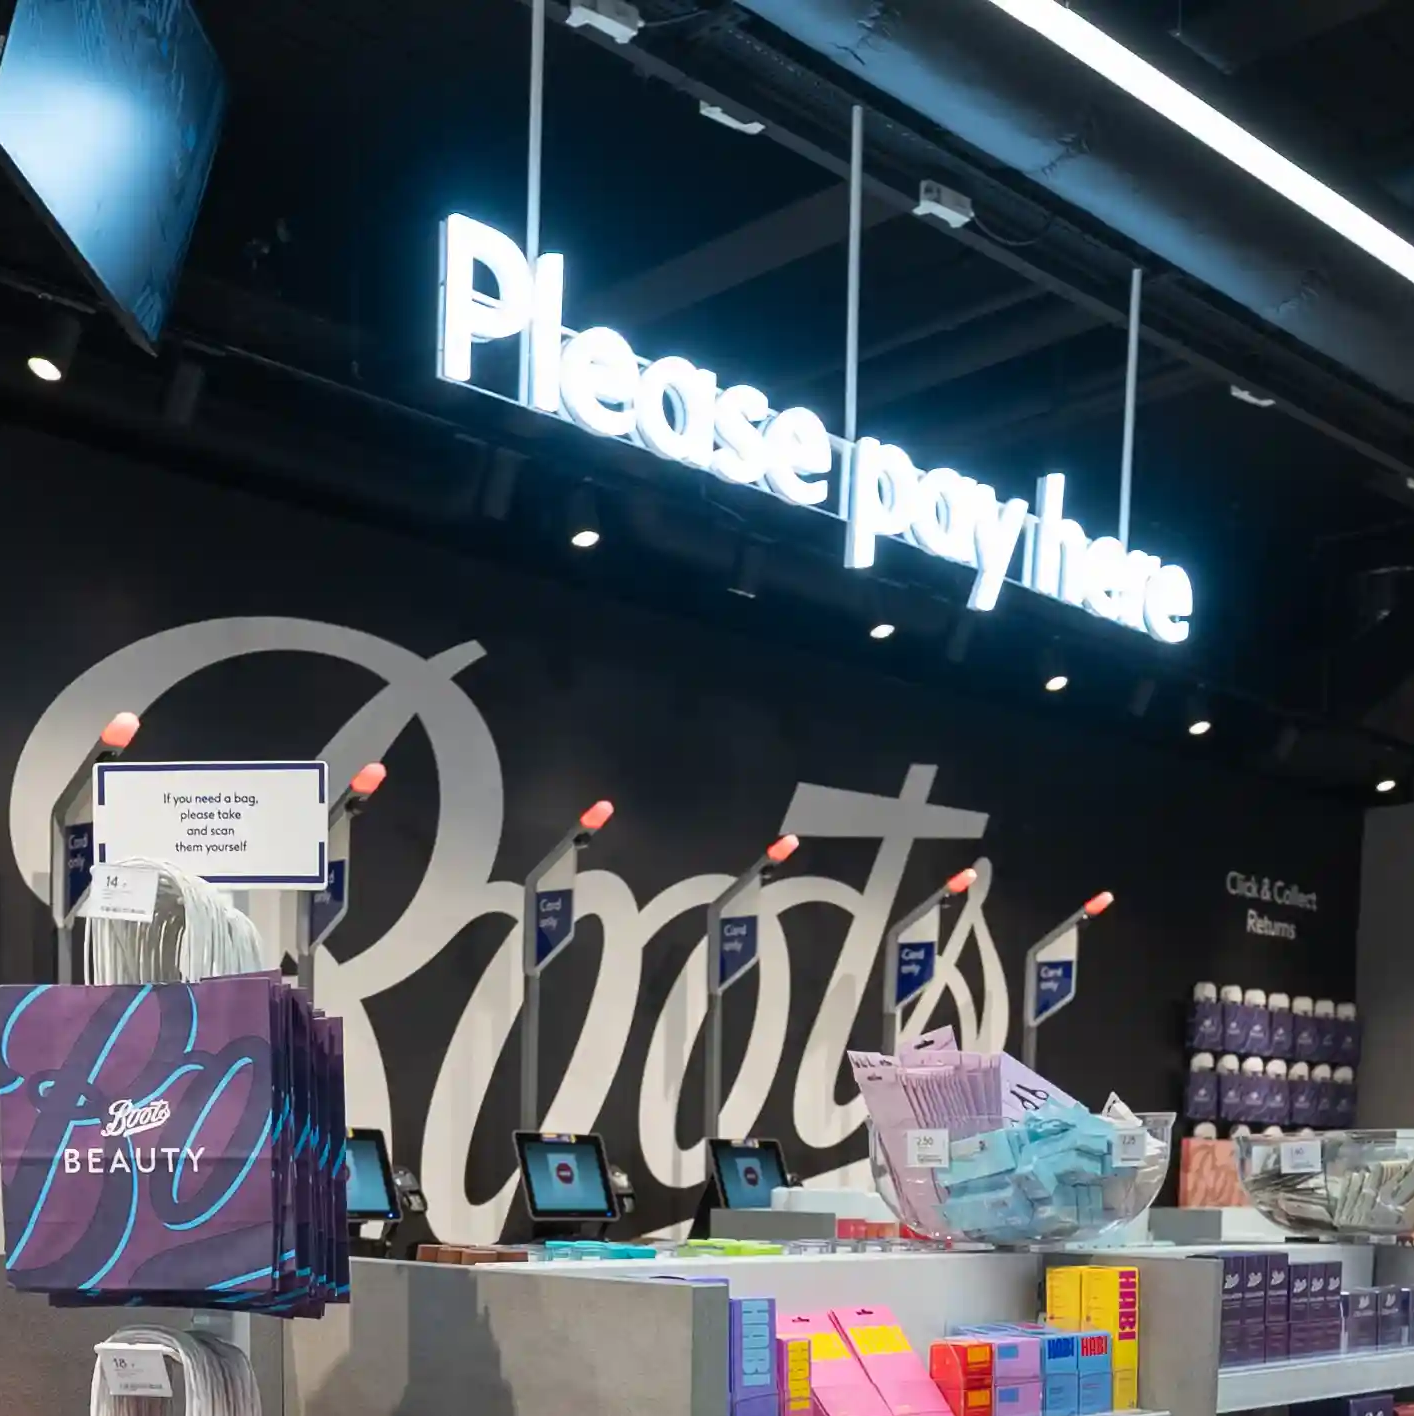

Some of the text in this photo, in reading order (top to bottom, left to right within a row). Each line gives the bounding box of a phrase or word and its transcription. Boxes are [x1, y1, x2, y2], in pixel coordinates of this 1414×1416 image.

[437, 211, 1193, 645] Please pay here
[163, 792, 259, 807] If you need a bag,
[179, 808, 242, 822] please take
[186, 825, 235, 836] and scan
[175, 841, 248, 855] them yourself
[1225, 870, 1318, 911] Click & Collect
[539, 897, 562, 912] Card
[723, 923, 748, 937] Card
[1246, 908, 1297, 940] Returns
[100, 1099, 171, 1137] Boots
[63, 1147, 206, 1175] BEAUTY
